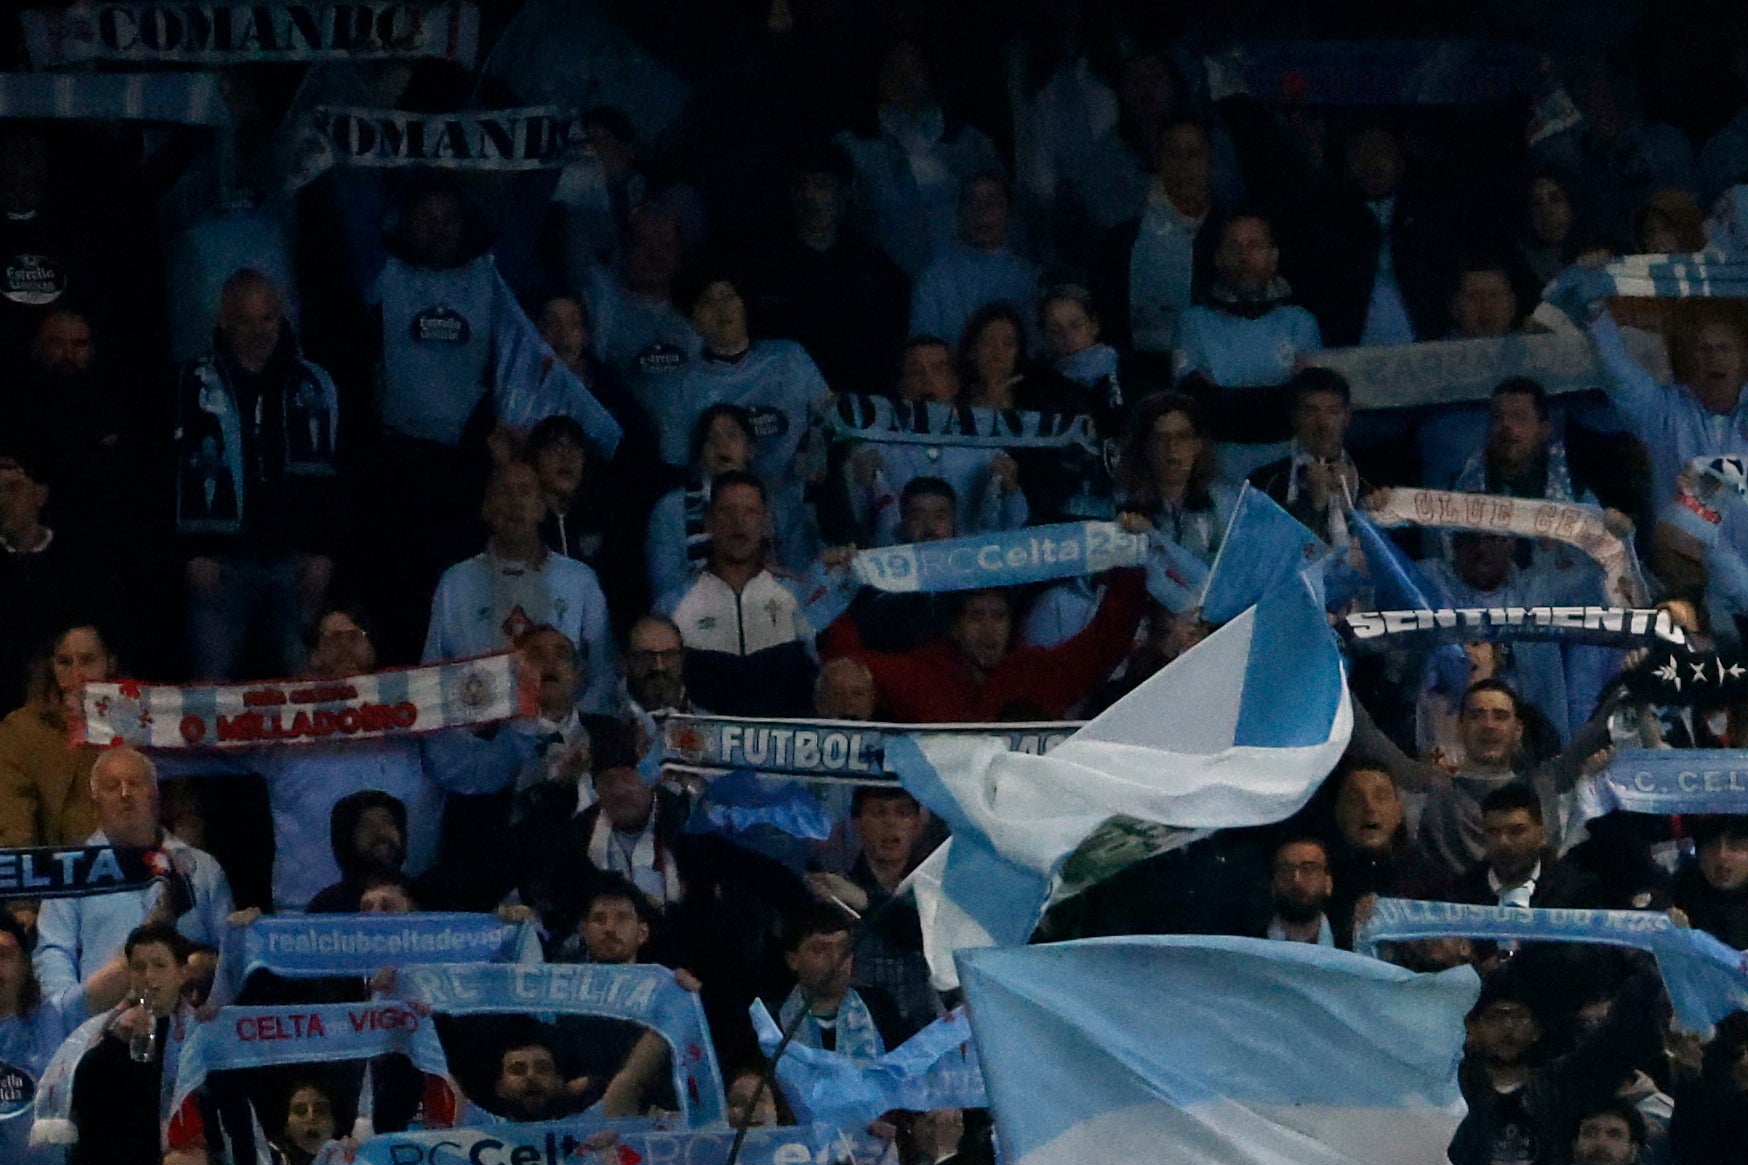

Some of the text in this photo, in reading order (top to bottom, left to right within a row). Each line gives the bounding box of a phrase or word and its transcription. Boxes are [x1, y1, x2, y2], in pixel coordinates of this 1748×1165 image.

[325, 114, 578, 162] OMAND
[977, 537, 1080, 570] Celta
[720, 726, 864, 769] FUTBOL
[236, 1002, 418, 1042] CELTA VIGO
